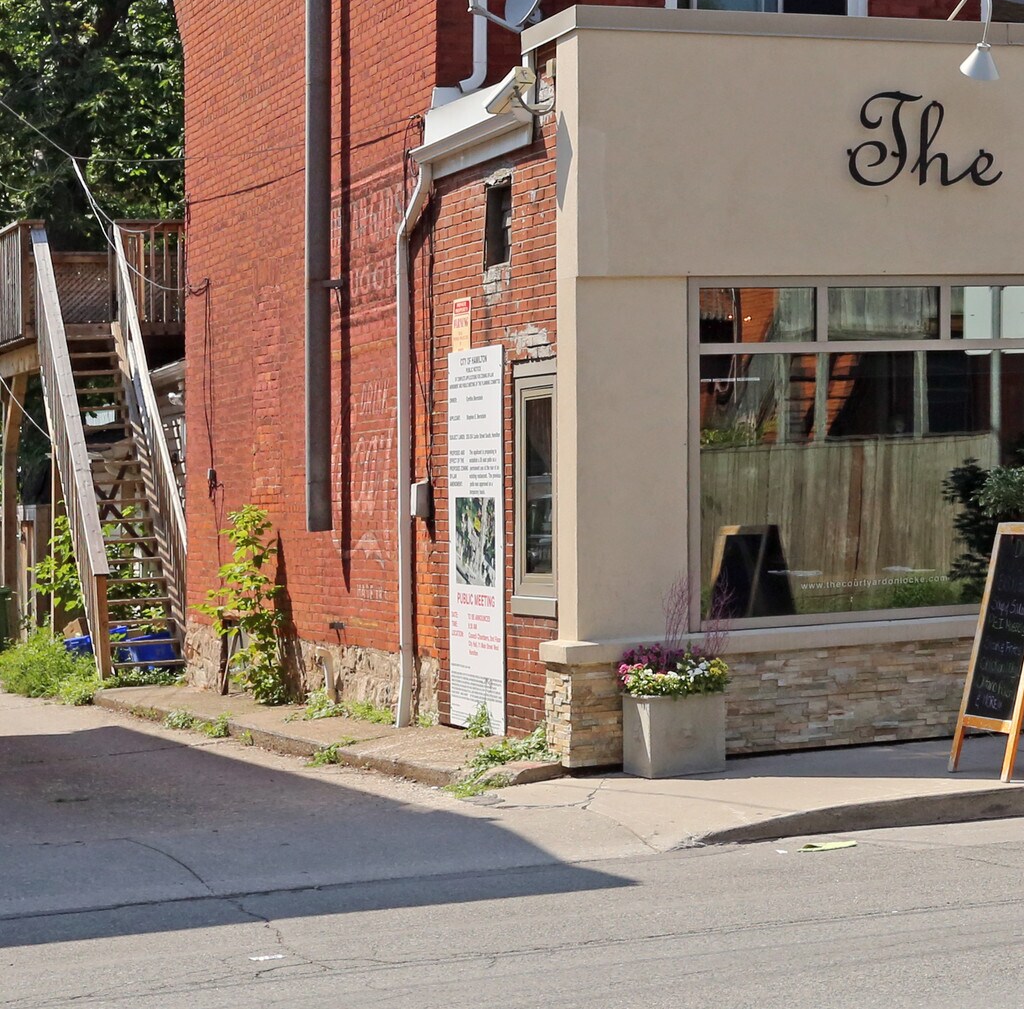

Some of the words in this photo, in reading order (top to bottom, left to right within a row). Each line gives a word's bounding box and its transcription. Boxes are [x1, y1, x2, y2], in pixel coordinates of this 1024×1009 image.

[847, 90, 1003, 188] The
[801, 575, 949, 590] www.thecourtyardonlocke.com
[457, 592, 473, 605] PUBLIC
[474, 594, 495, 608] MEETING
